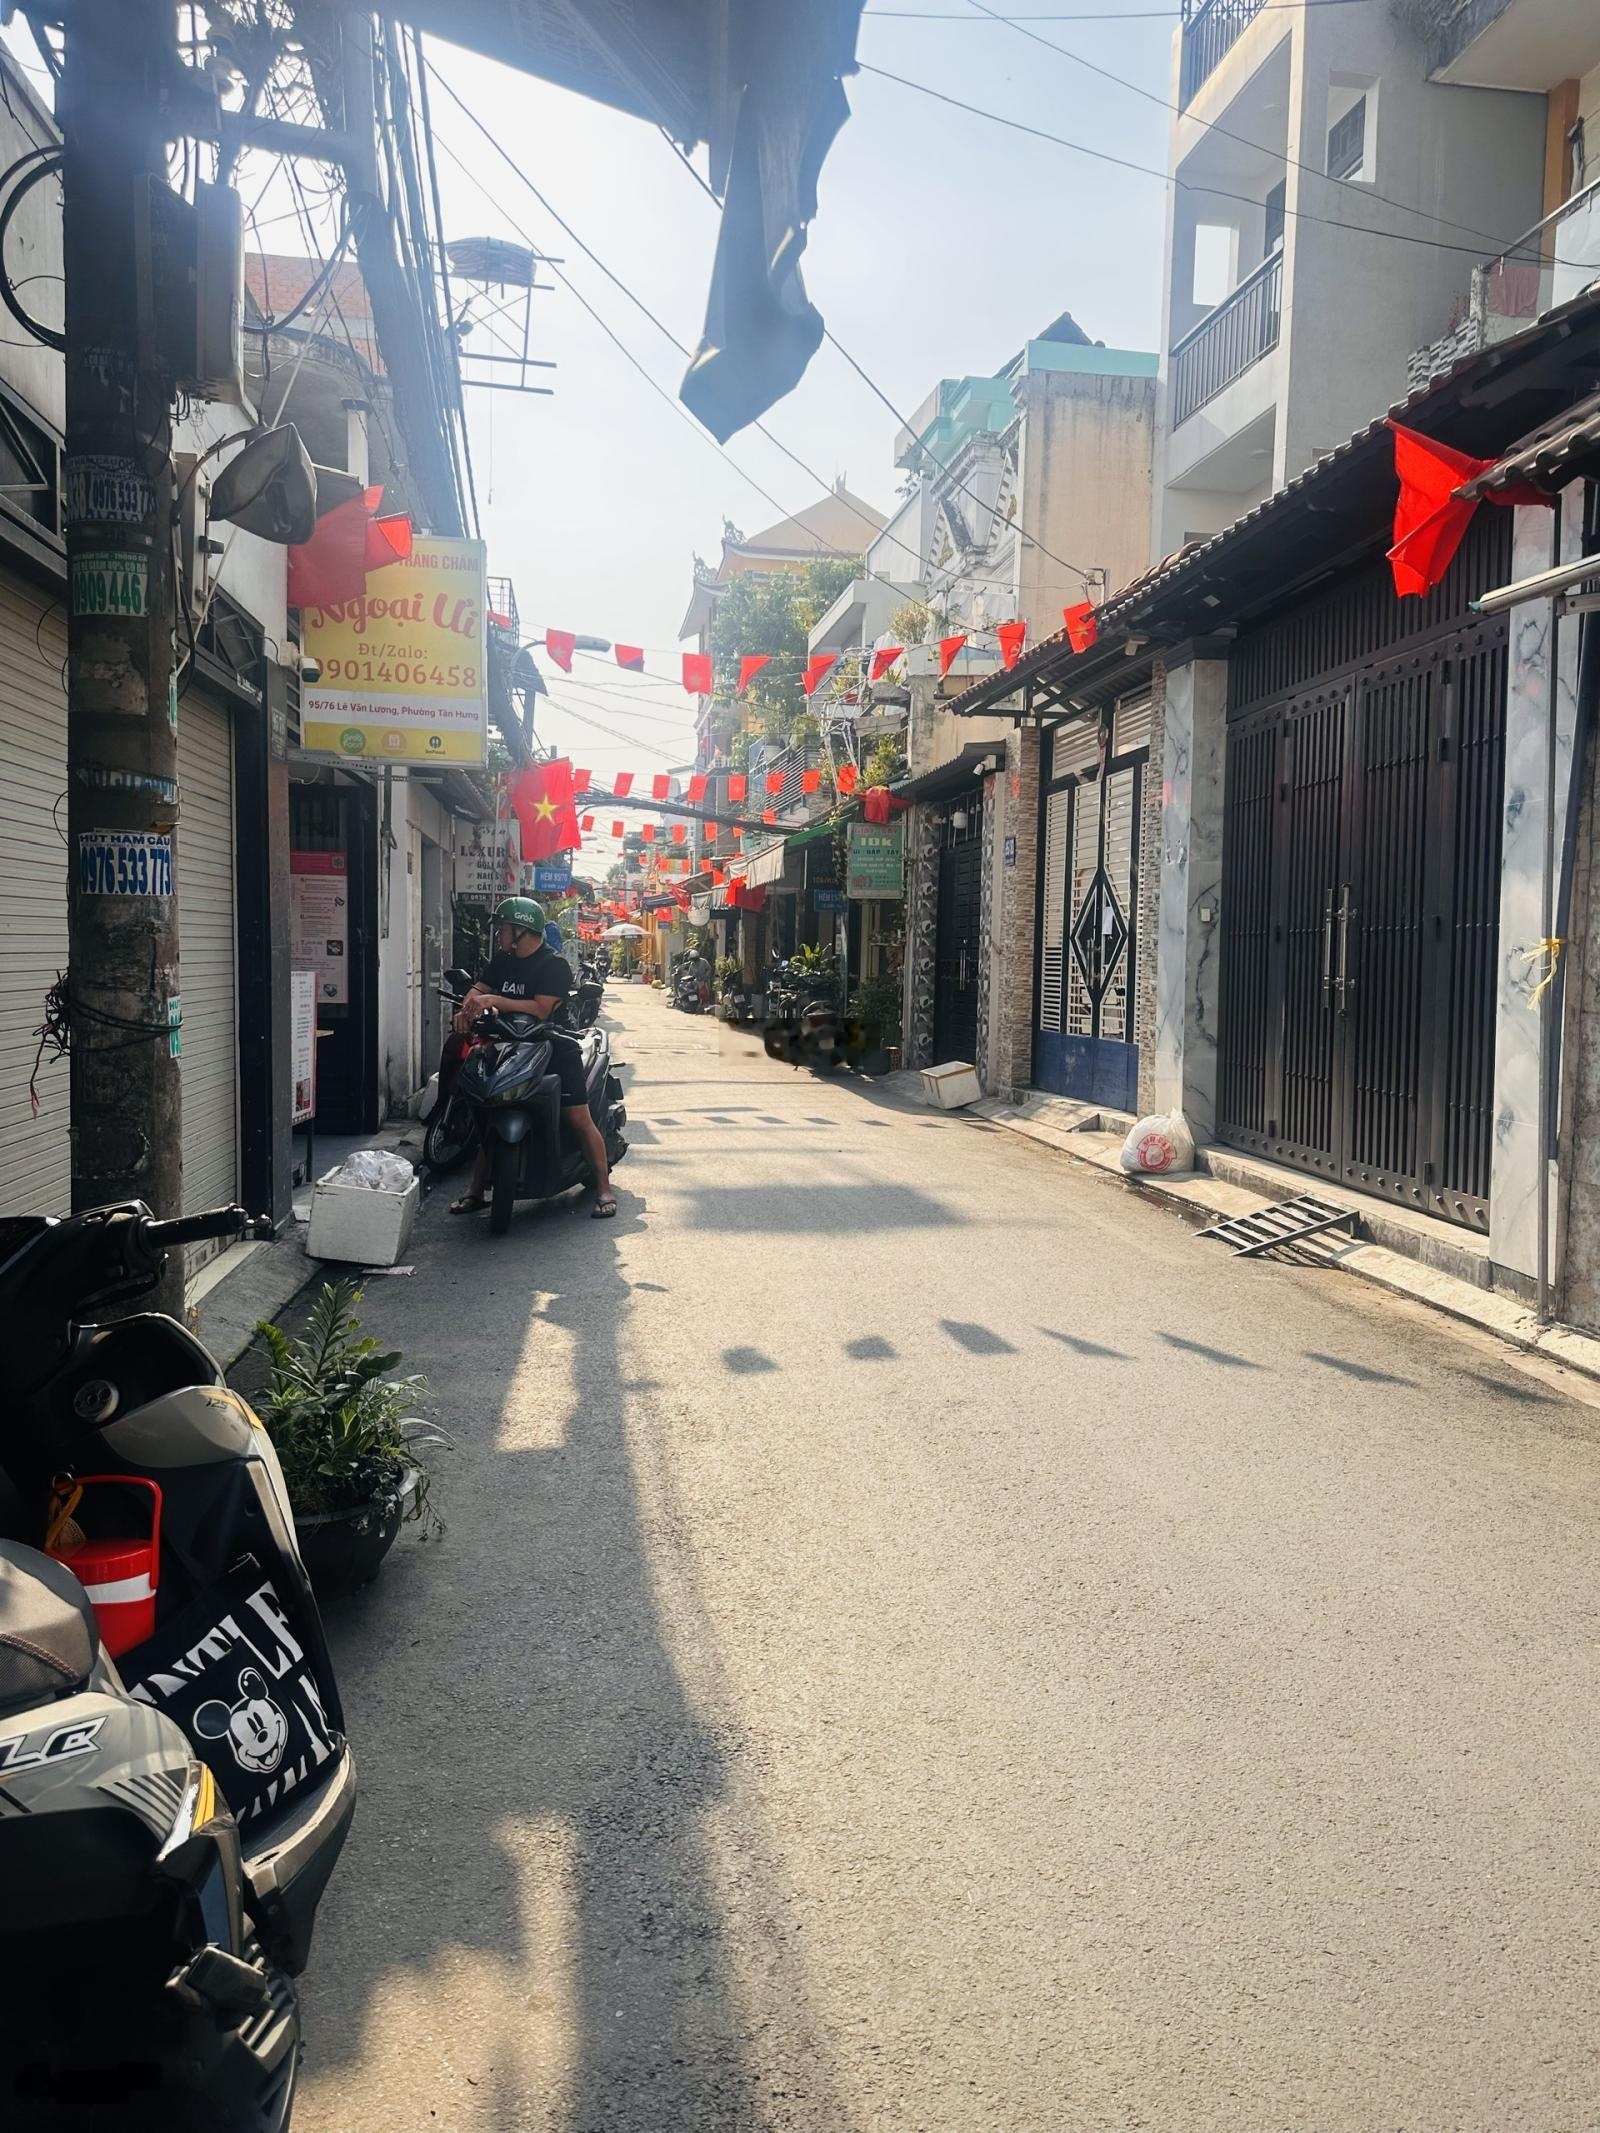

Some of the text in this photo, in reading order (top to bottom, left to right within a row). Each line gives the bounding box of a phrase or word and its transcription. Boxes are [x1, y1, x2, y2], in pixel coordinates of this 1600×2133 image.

[308, 700, 335, 711] 95/76
[81, 846, 171, 895] 0976.533.773
[514, 911, 535, 923] Grab
